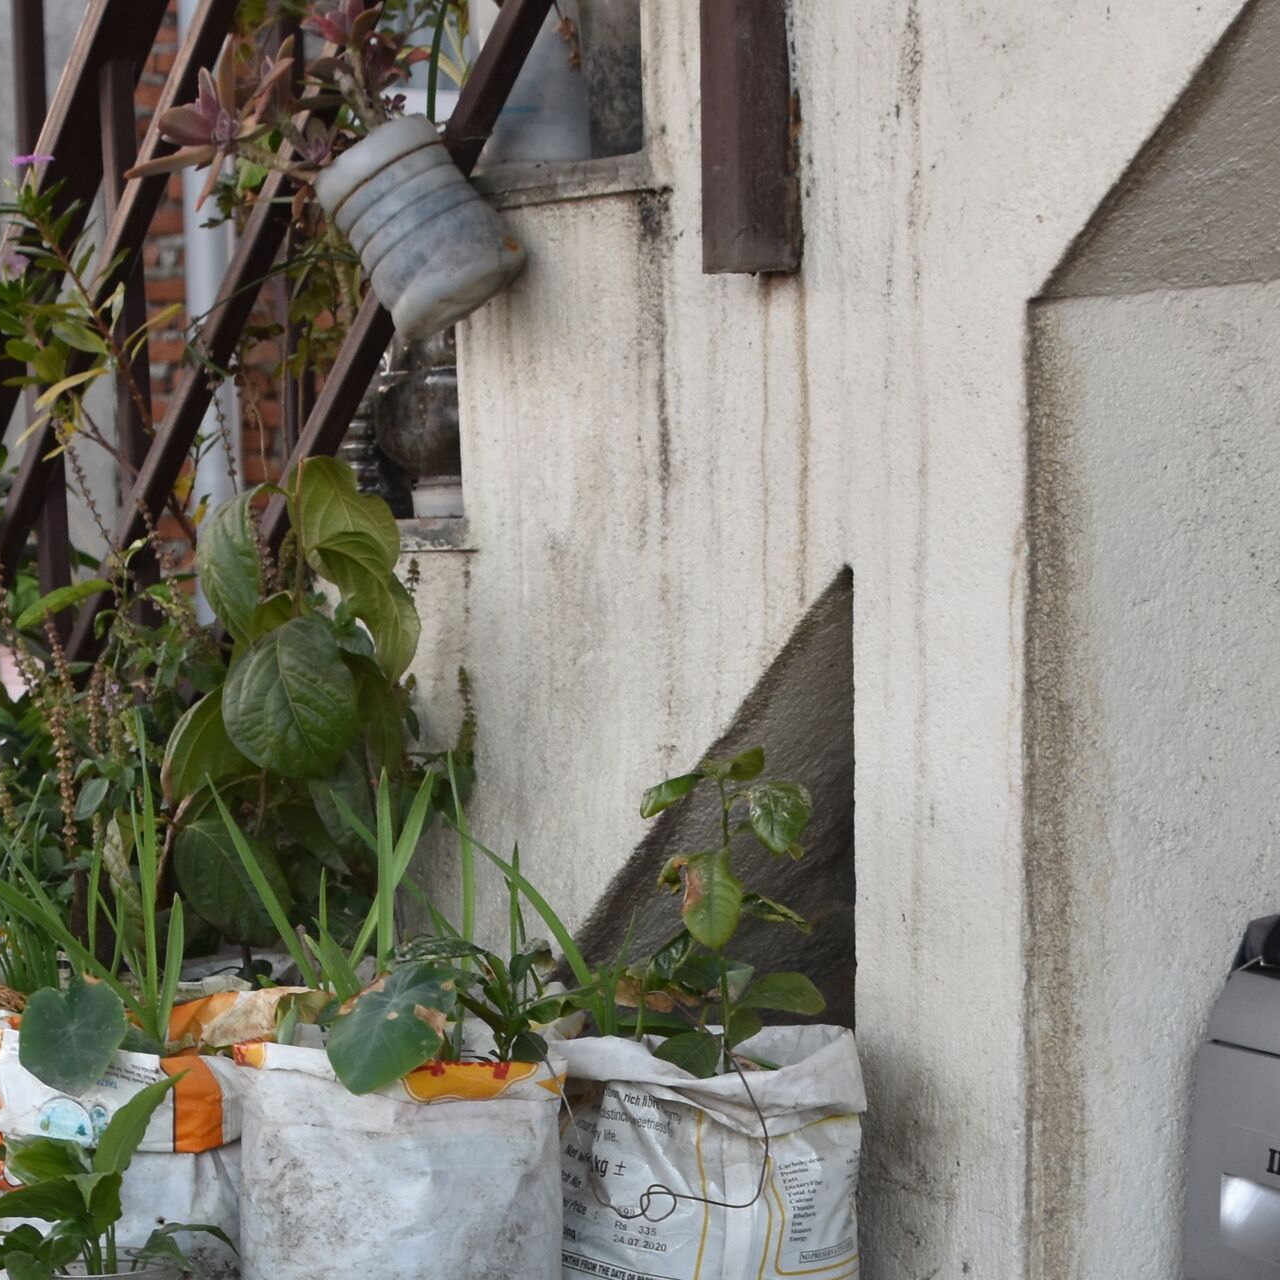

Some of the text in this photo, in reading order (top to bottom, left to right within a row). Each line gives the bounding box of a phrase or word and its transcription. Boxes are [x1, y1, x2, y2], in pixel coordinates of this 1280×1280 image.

[624, 1092, 640, 1105] rich
[614, 1220, 658, 1236] Rs 335
[562, 1252, 580, 1266] ONTHS
[580, 1260, 598, 1272] FROM
[598, 1264, 610, 1276] THE
[610, 1268, 626, 1280] DATE
